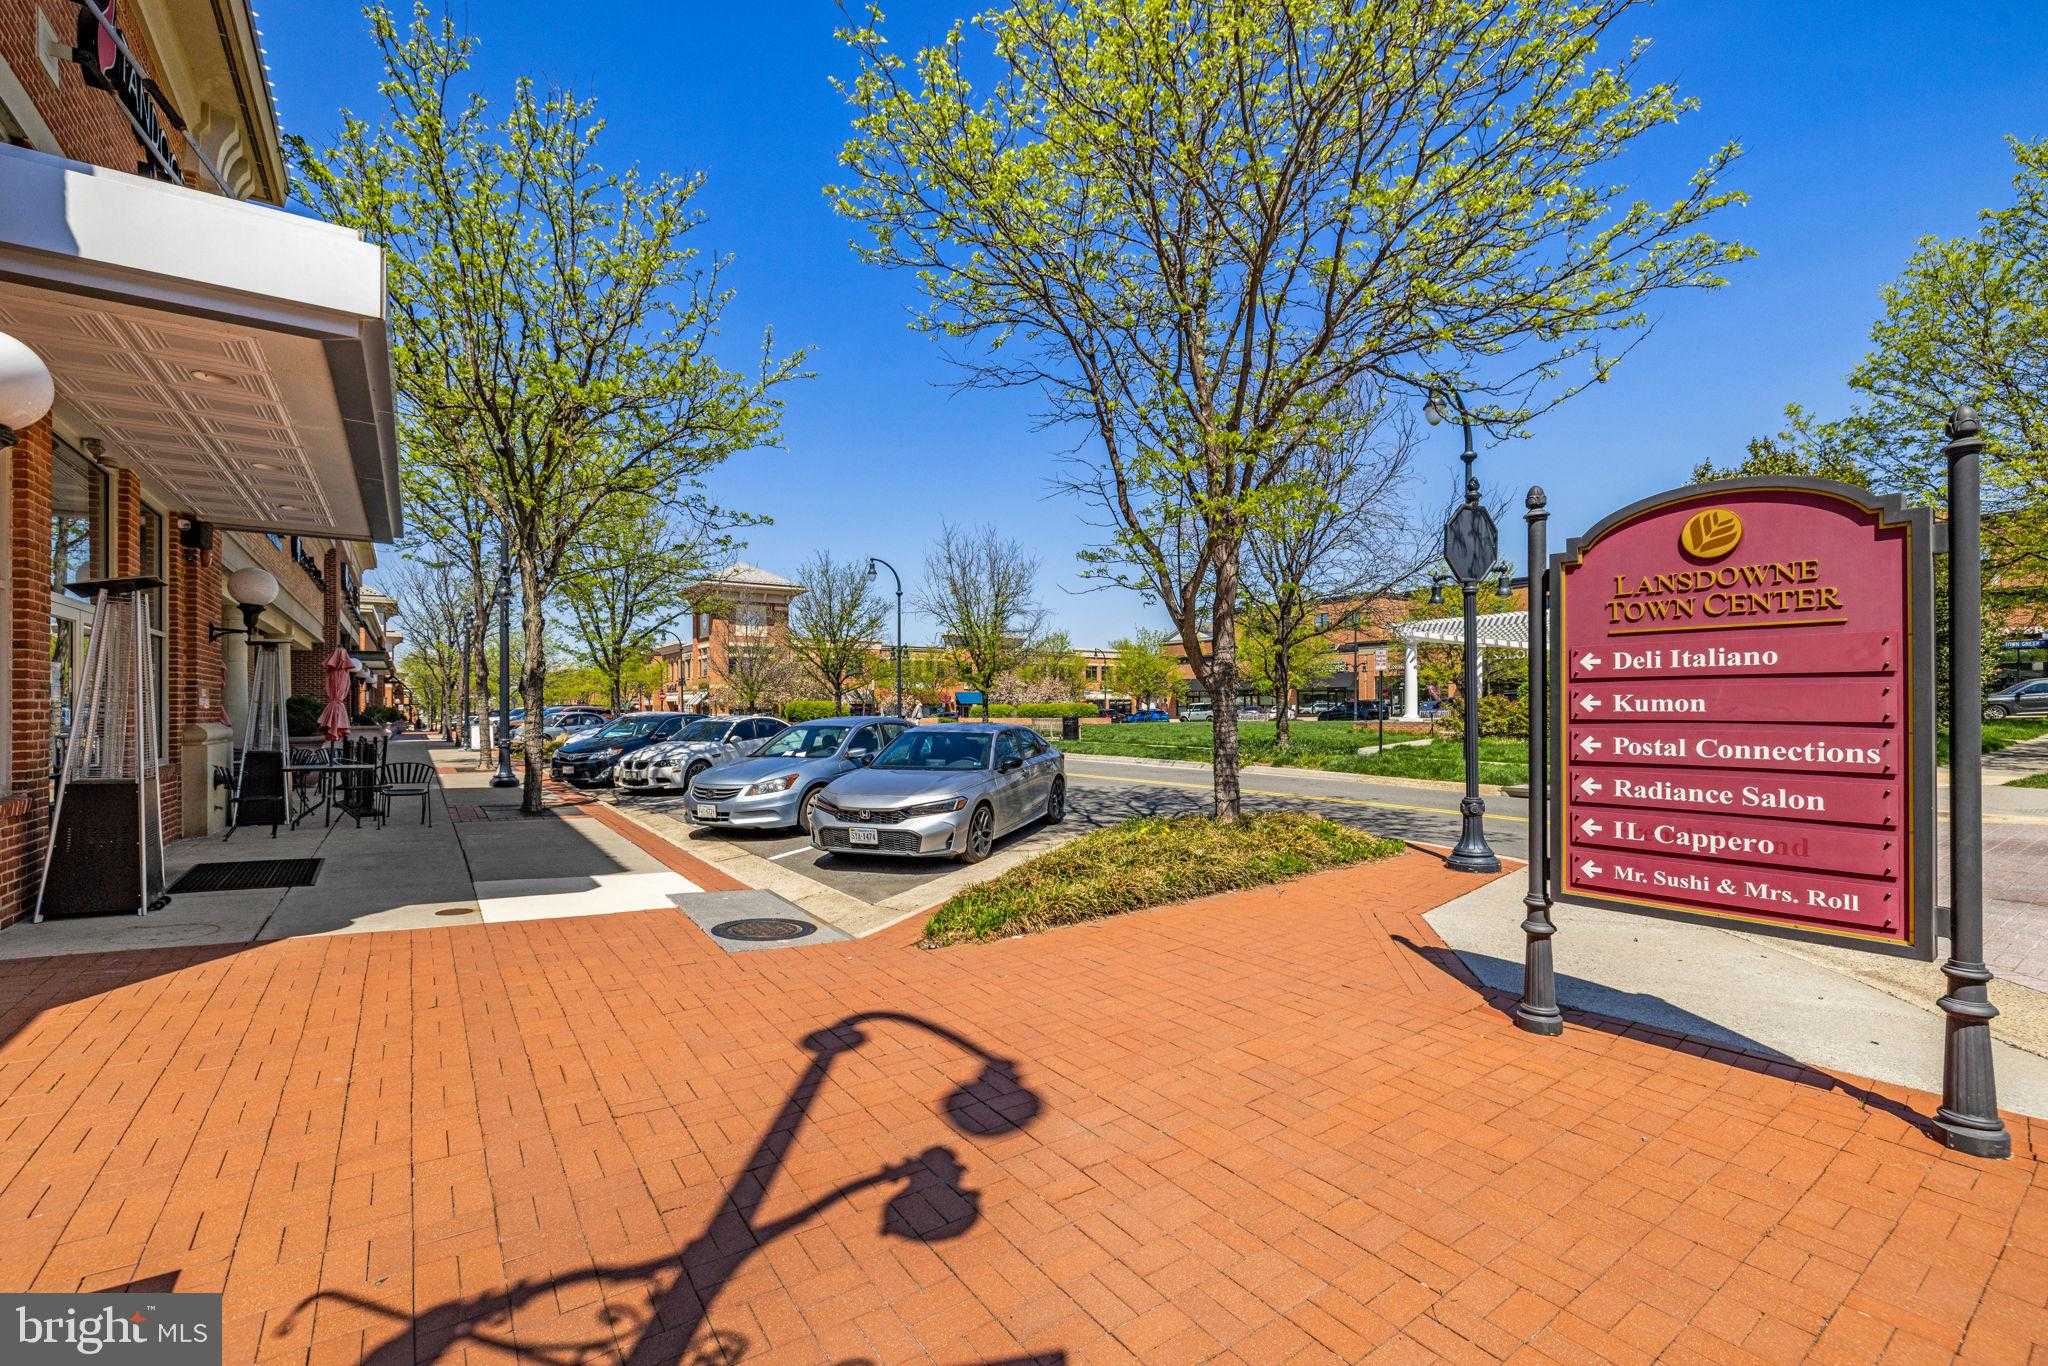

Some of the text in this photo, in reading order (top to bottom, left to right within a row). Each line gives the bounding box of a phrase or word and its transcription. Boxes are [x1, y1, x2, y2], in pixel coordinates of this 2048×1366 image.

[1614, 560, 1819, 597] LANSDOWNE
[1605, 587, 1844, 624] TOWN CENTER
[1613, 647, 1779, 670] Deli Italiano
[1612, 694, 1707, 713] Kumon
[1614, 737, 1881, 765] Postal Connections
[1614, 779, 1826, 812] Radiance Salon
[1613, 821, 1645, 841] IL
[1653, 825, 1775, 855] Cappero
[1614, 866, 1860, 913] Mr. Sushi & Mrs. Roll
